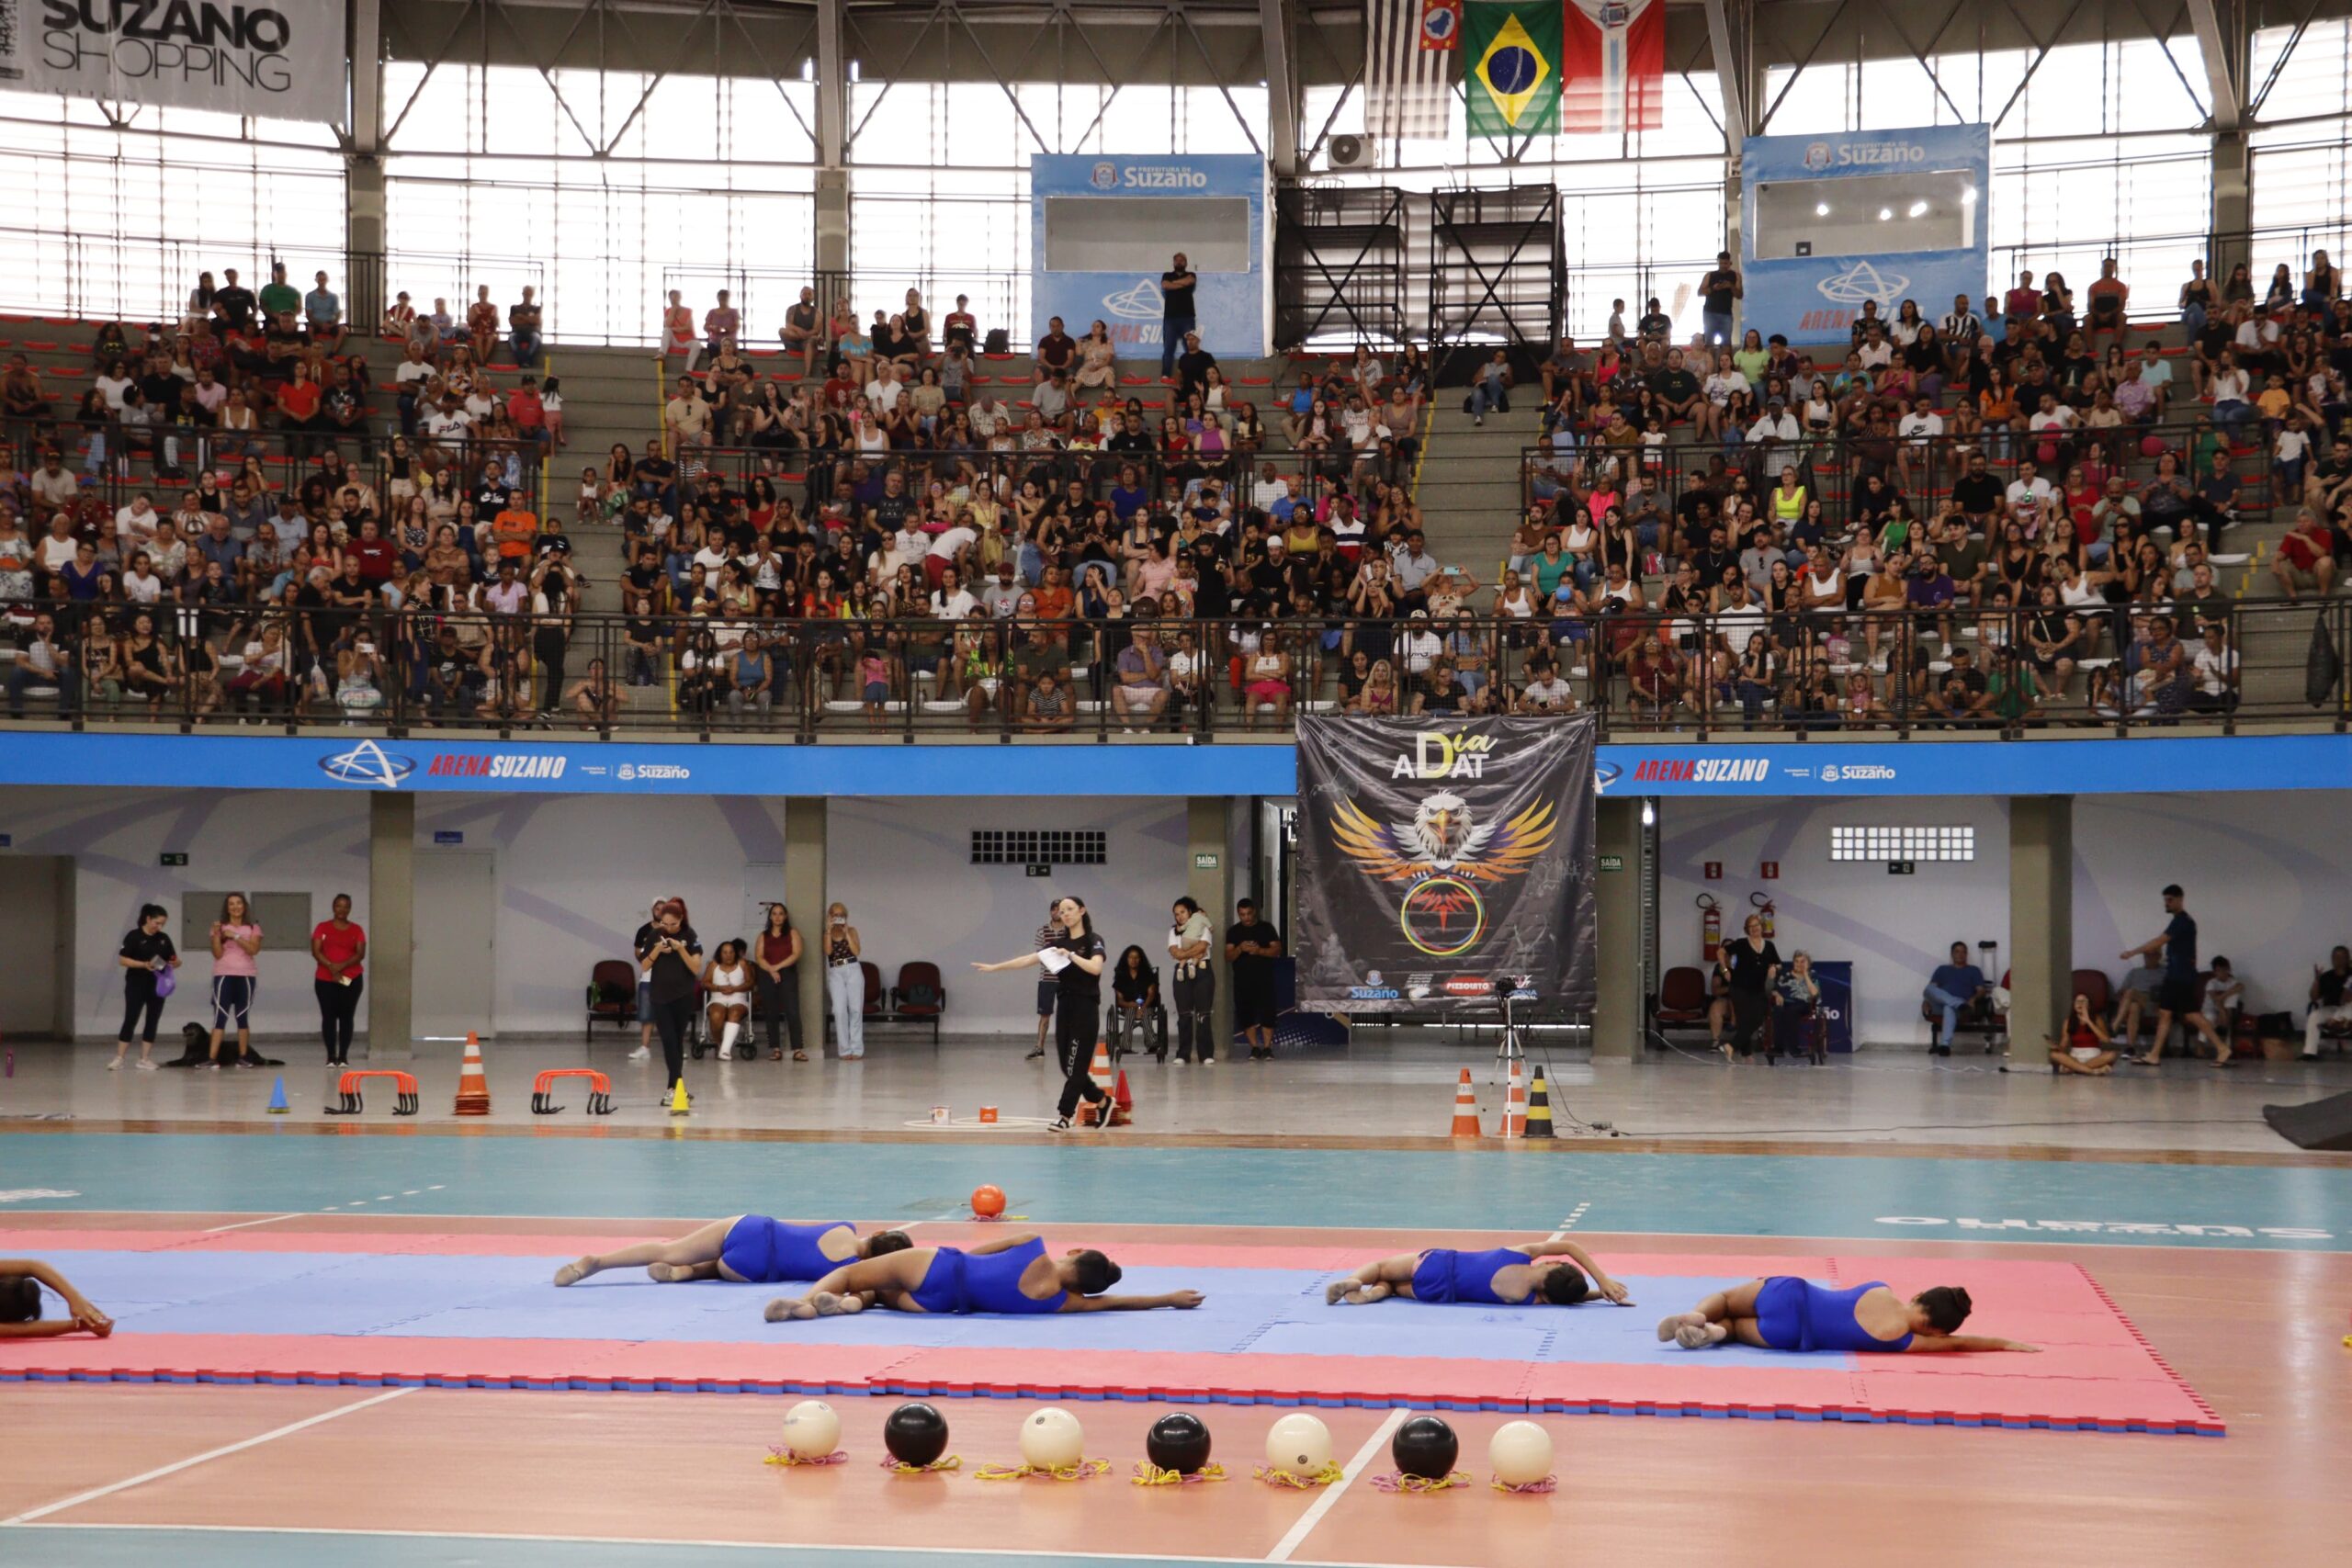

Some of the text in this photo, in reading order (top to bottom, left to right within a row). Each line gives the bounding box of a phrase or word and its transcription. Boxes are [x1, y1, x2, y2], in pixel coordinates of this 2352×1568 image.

[42, 0, 291, 53] SUZANO
[43, 30, 291, 92] SHOPPING
[1838, 143, 1925, 165] Suzano
[1124, 166, 1206, 187] Suzano
[638, 764, 690, 779] Suzano
[1841, 765, 1895, 779] Suzano
[1196, 854, 1217, 864] SAÍDA
[1600, 855, 1622, 866] SAÍDA
[1351, 987, 1398, 998] Suzano
